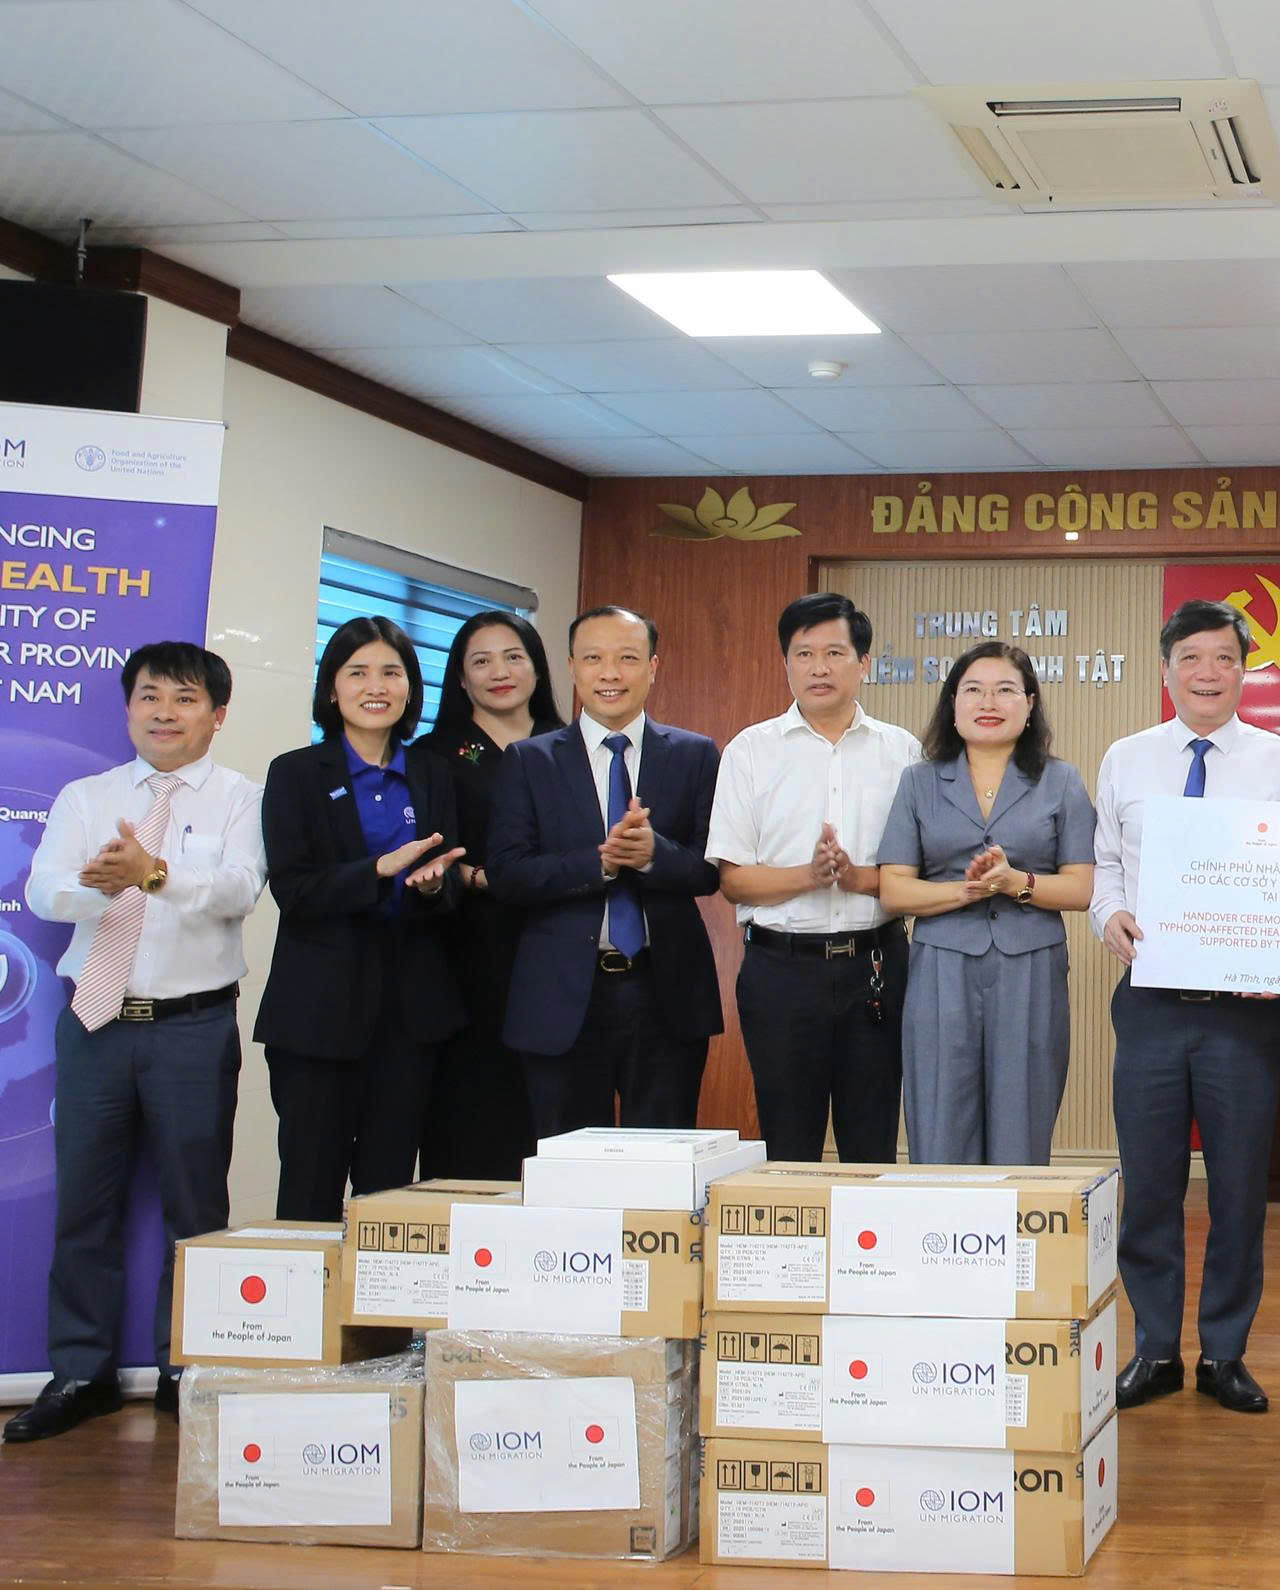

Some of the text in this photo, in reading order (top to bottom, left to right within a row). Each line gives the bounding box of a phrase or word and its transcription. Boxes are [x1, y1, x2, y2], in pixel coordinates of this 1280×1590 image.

[871, 481, 1009, 534] ĐẢNG
[1024, 484, 1158, 540] CỘNG
[1172, 476, 1277, 530] SẢN
[0, 523, 96, 551] NCING
[1, 560, 151, 597] EALTH
[54, 607, 97, 631] OF
[913, 603, 1068, 639] TRUNG TÂM
[20, 642, 131, 669] PROVIN
[1075, 648, 1125, 688] TẬT
[9, 679, 81, 704] NAM
[0, 807, 49, 824] Quang
[1190, 859, 1226, 872] CHÍNH
[1229, 861, 1253, 873] PHỦ
[1181, 874, 1206, 885] CHO
[1208, 874, 1231, 886] CÁC
[1233, 876, 1250, 887] CƠ
[1252, 876, 1268, 888] SỞ
[1270, 878, 1277, 888] Y
[1262, 891, 1277, 903] TẠI
[1183, 912, 1237, 922] HANDOVER
[1159, 922, 1257, 936] TYPHOON-AFFECTED
[1200, 937, 1257, 948] SUPPORTED
[1260, 939, 1272, 949] BY
[1224, 974, 1236, 983] Hà
[953, 1233, 1005, 1255] IOM
[563, 1252, 611, 1274] IOM
[921, 1257, 1006, 1266] UN MIGRATION
[533, 1274, 612, 1285] UN MIGRATION
[848, 1268, 868, 1277] People
[492, 1287, 510, 1295] Japan
[242, 1321, 262, 1330] From
[212, 1330, 292, 1343] the People of Japan
[943, 1363, 995, 1384] IOM
[912, 1386, 995, 1397] UN MIGRATION
[840, 1398, 860, 1406] People
[496, 1431, 542, 1450] IOM
[331, 1444, 380, 1464] IOM
[471, 1452, 543, 1461] UN MIGRATION
[303, 1467, 381, 1476] UN MIGRATION
[235, 1481, 254, 1489] People
[263, 1481, 280, 1489] Japan
[951, 1491, 1004, 1512] IOM
[919, 1514, 1004, 1524] UN MIGRATION
[846, 1526, 867, 1534] People
